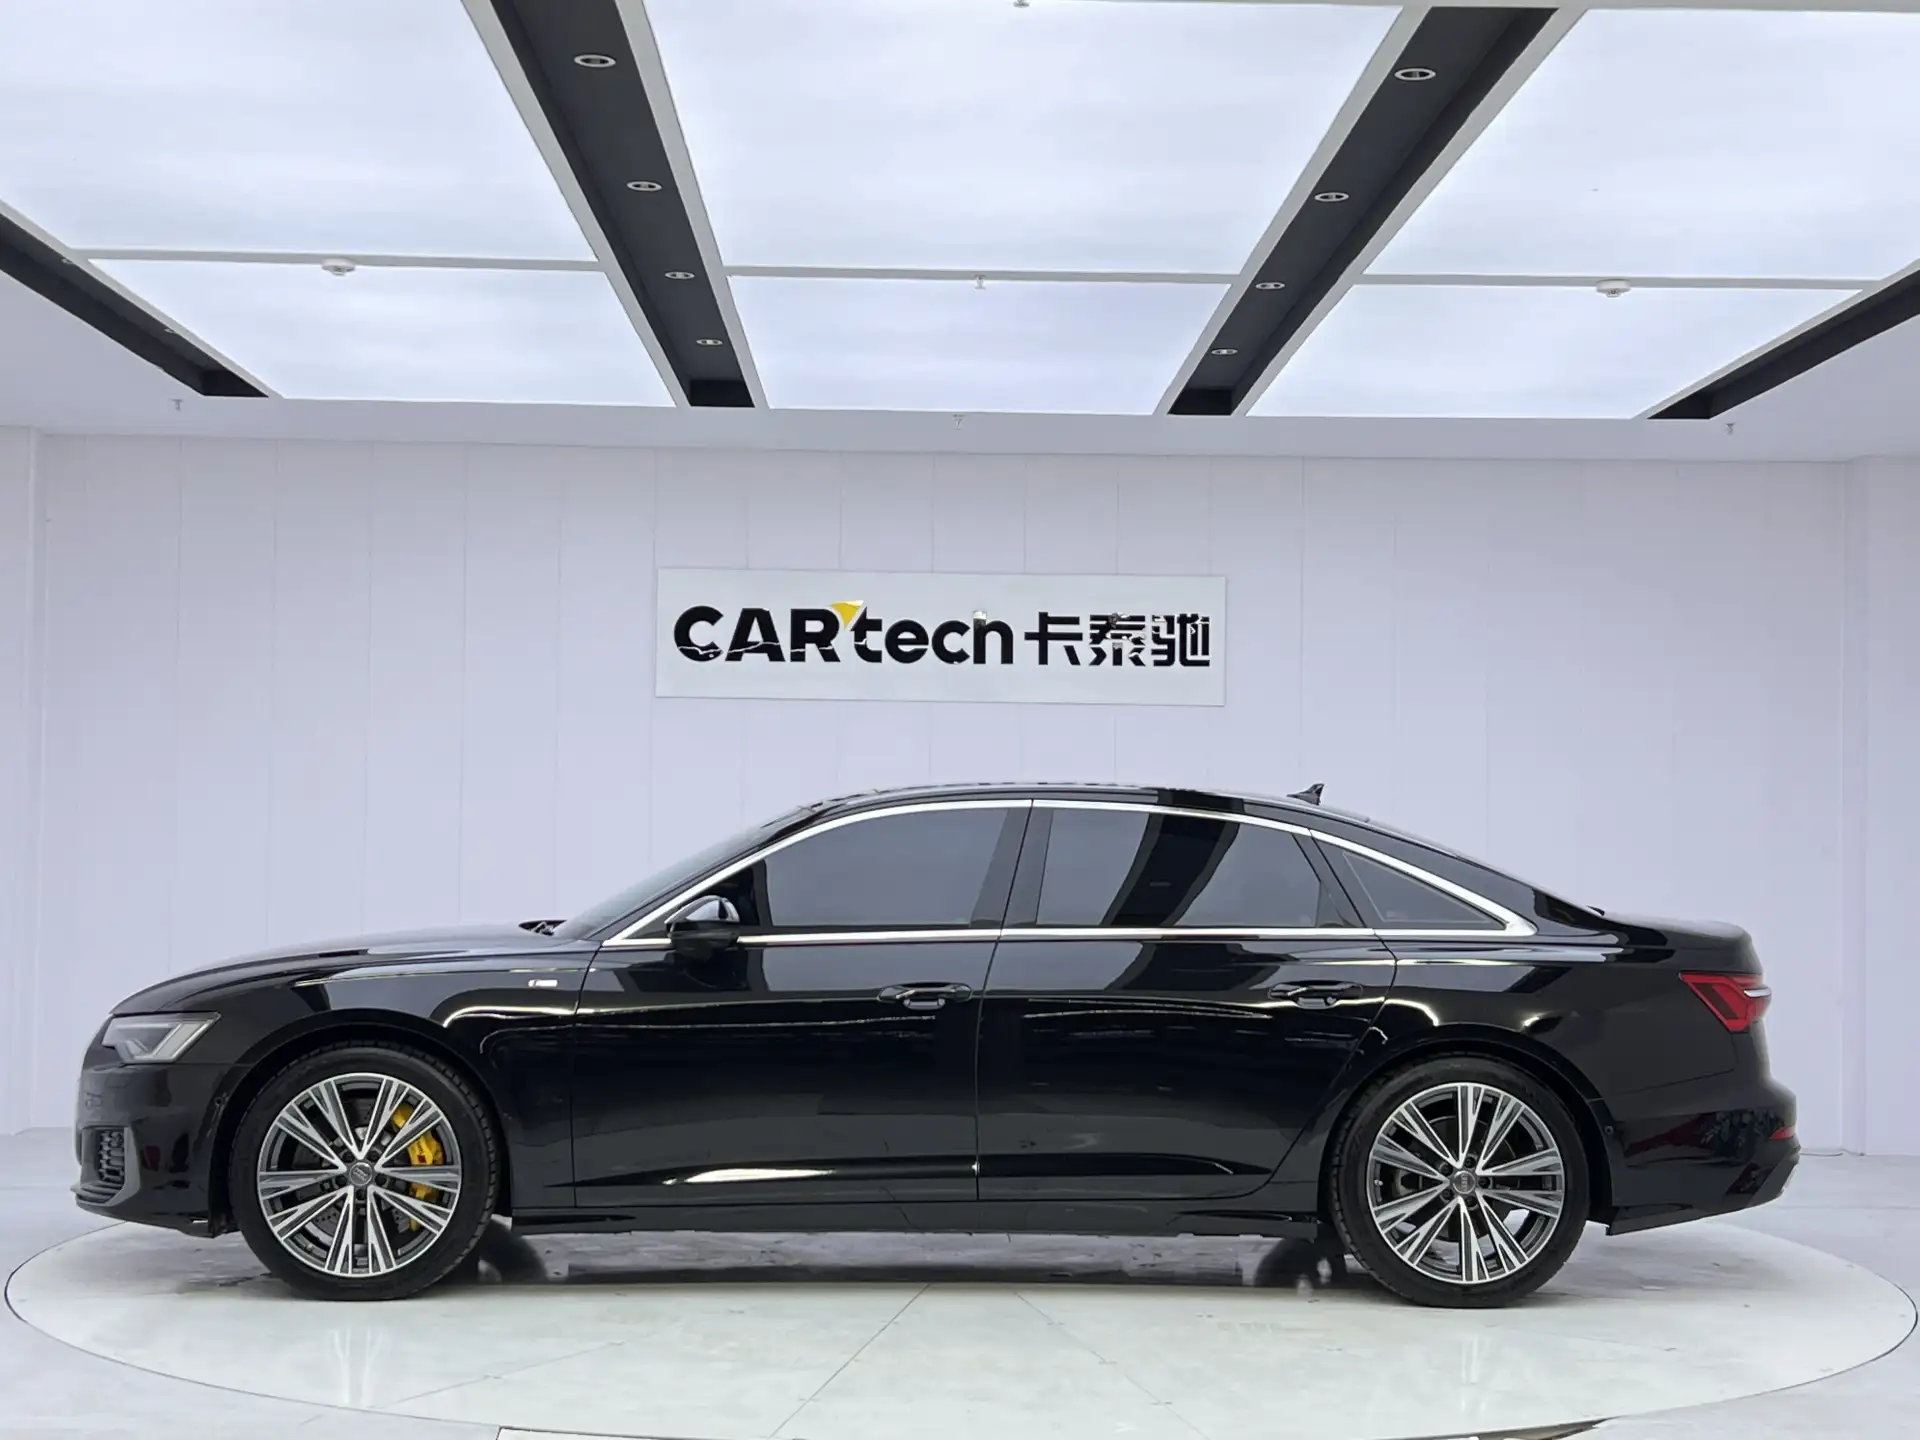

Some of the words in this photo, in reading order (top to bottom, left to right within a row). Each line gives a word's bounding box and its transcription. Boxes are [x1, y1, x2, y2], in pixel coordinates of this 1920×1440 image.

[673, 604, 1014, 665] CARtech
[1024, 612, 1211, 667] 卡泰驰
